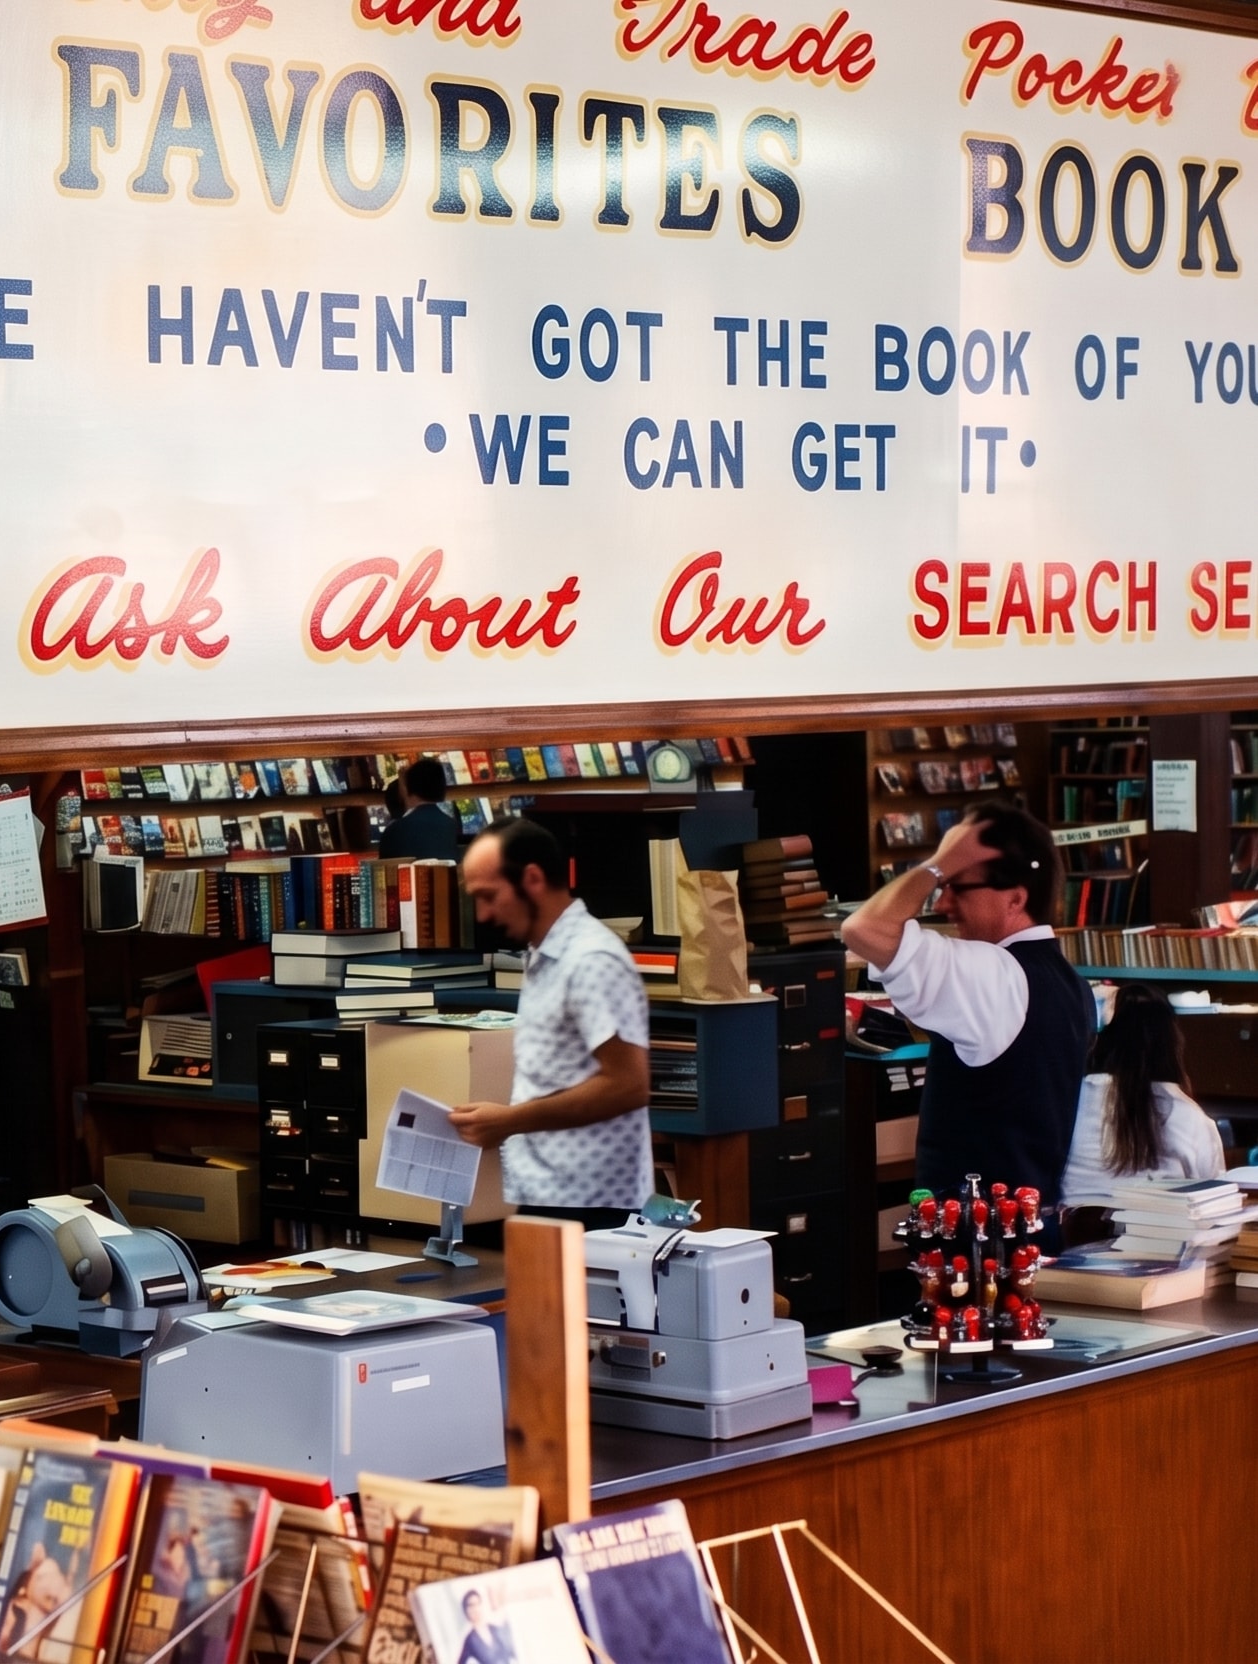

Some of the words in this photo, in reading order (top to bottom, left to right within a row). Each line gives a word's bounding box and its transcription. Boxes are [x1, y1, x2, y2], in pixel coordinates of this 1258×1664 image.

[621, 0, 877, 85] Trade
[54, 42, 803, 244] FAVORITES
[964, 135, 1240, 275] BOOK
[147, 279, 468, 374] HAVEN'T
[531, 303, 664, 383] GOT
[713, 315, 829, 390] THE
[874, 323, 1032, 397] BOOK
[1074, 334, 1141, 401] OF
[469, 413, 571, 487] WE
[622, 416, 745, 491] CAN
[791, 421, 897, 493] GET
[960, 424, 1009, 495] IT
[29, 546, 230, 662] Ask
[309, 548, 581, 653] About
[658, 550, 827, 647] Our
[912, 558, 1158, 641] SEARCH
